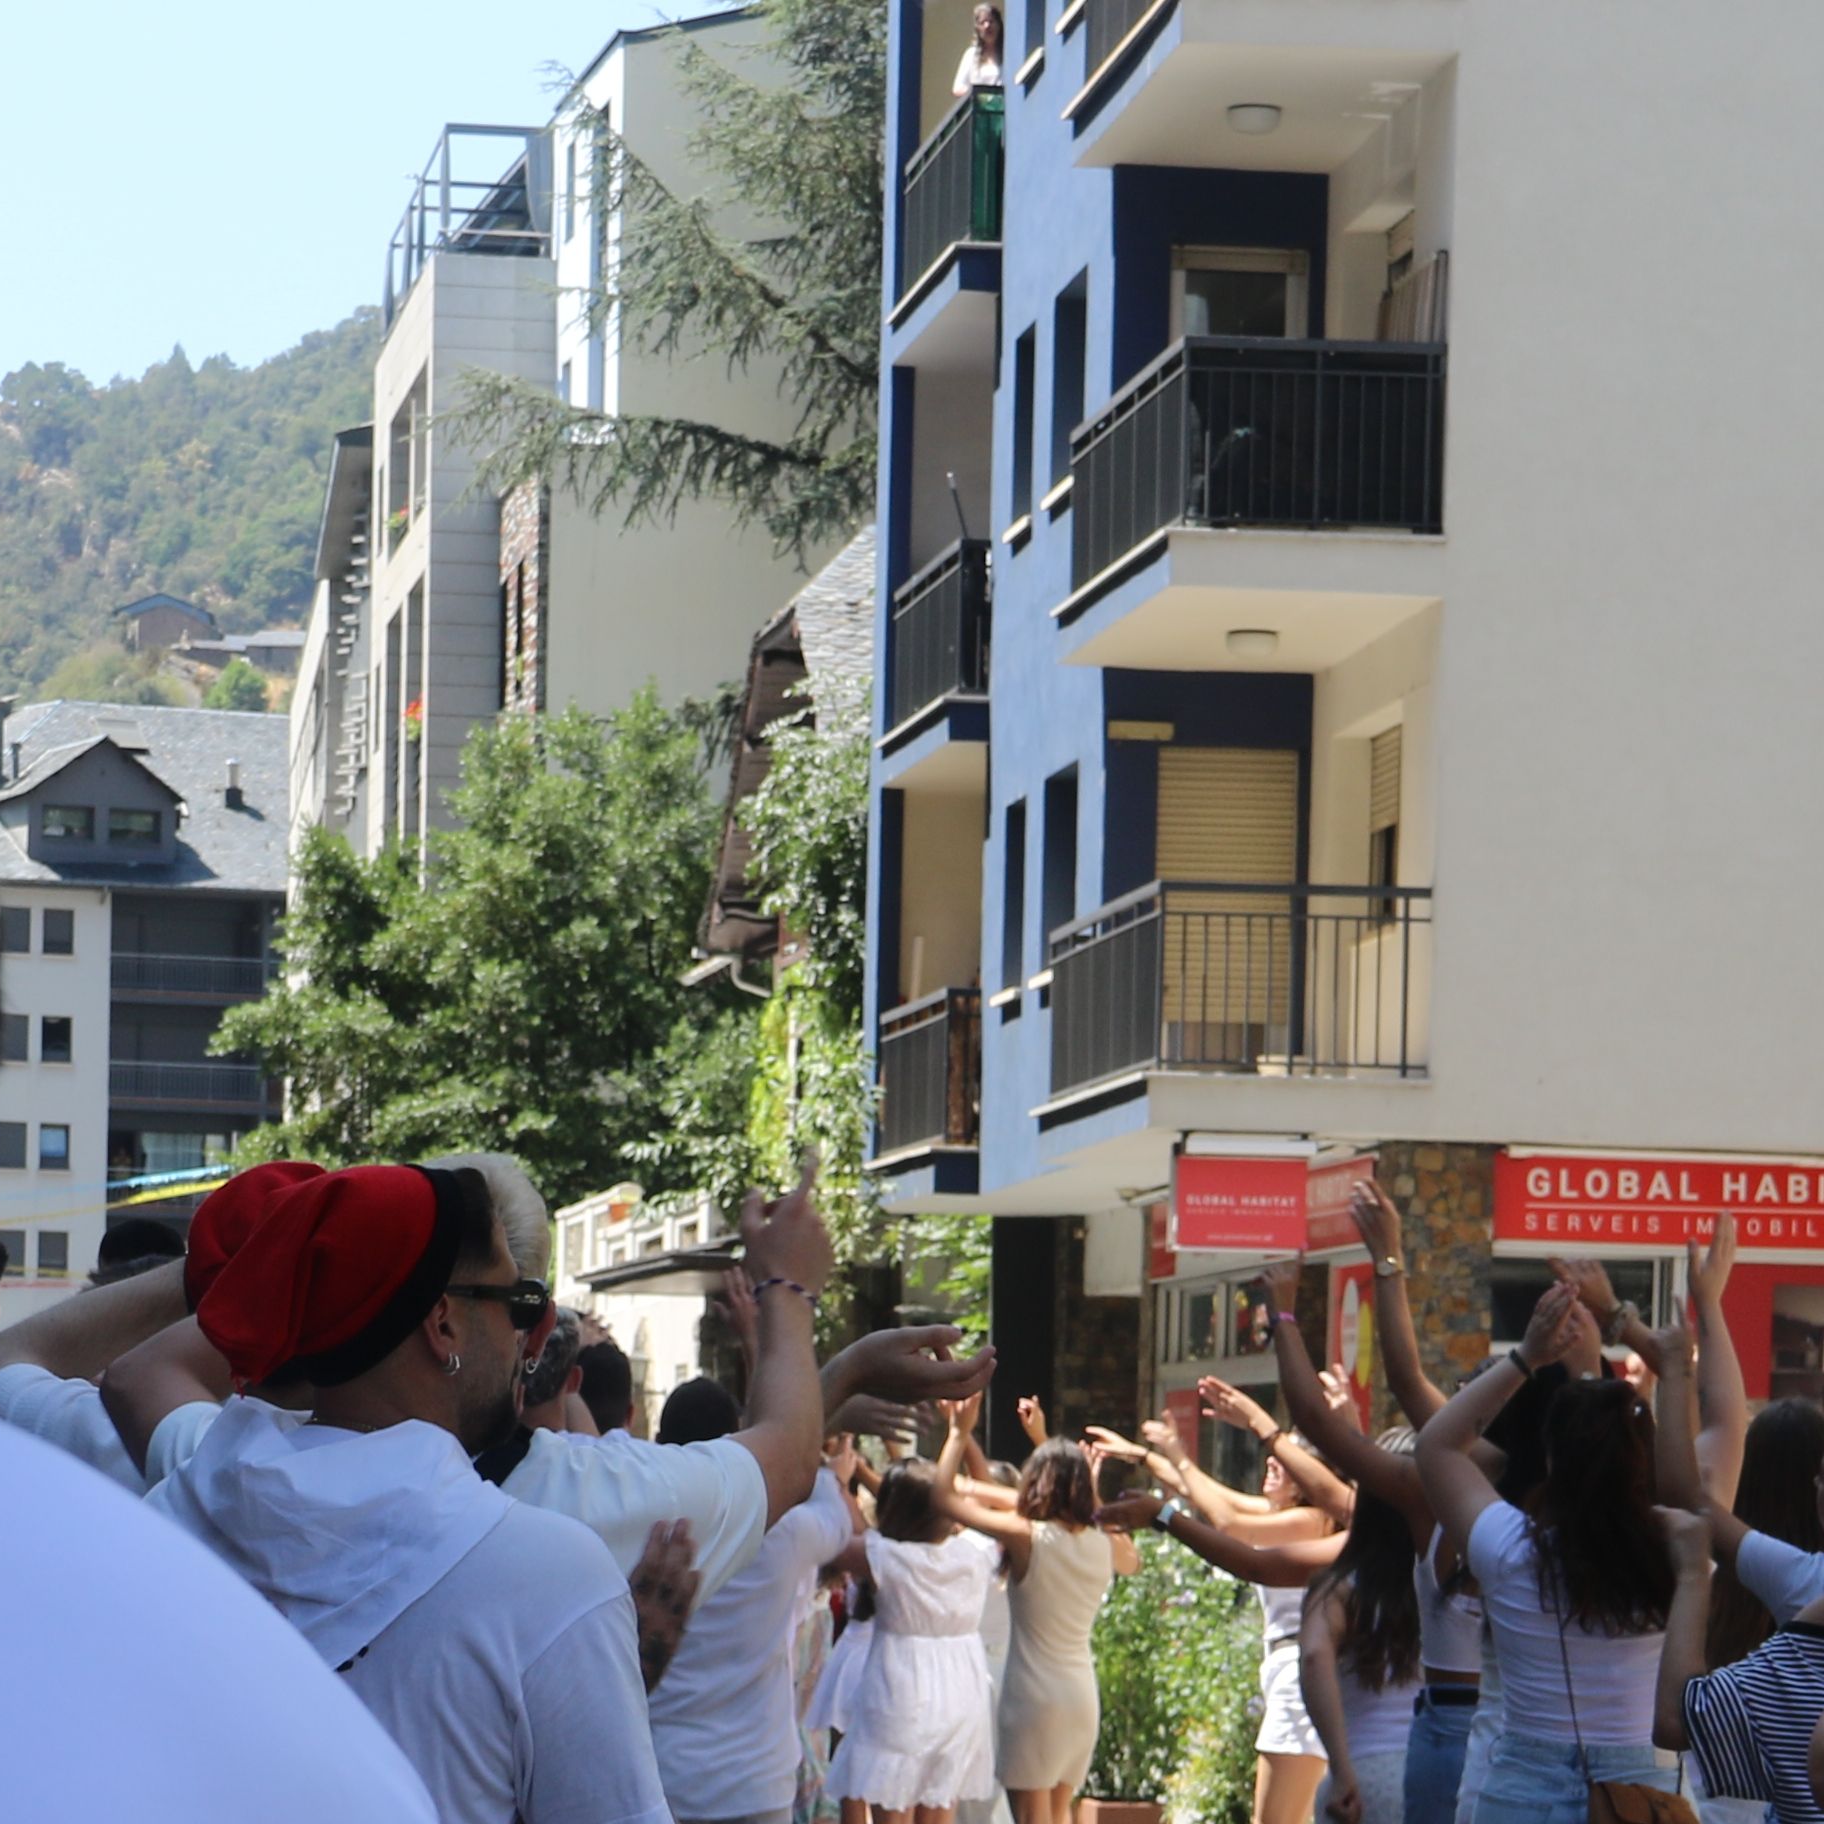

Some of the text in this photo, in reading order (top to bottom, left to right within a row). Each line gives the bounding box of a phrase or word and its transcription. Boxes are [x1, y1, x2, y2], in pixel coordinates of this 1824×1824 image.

[1526, 1167, 1700, 1202] GLOBAL
[1185, 1193, 1297, 1208] GLOBAL HABITAT
[1525, 1214, 1661, 1234] SERVEIS
